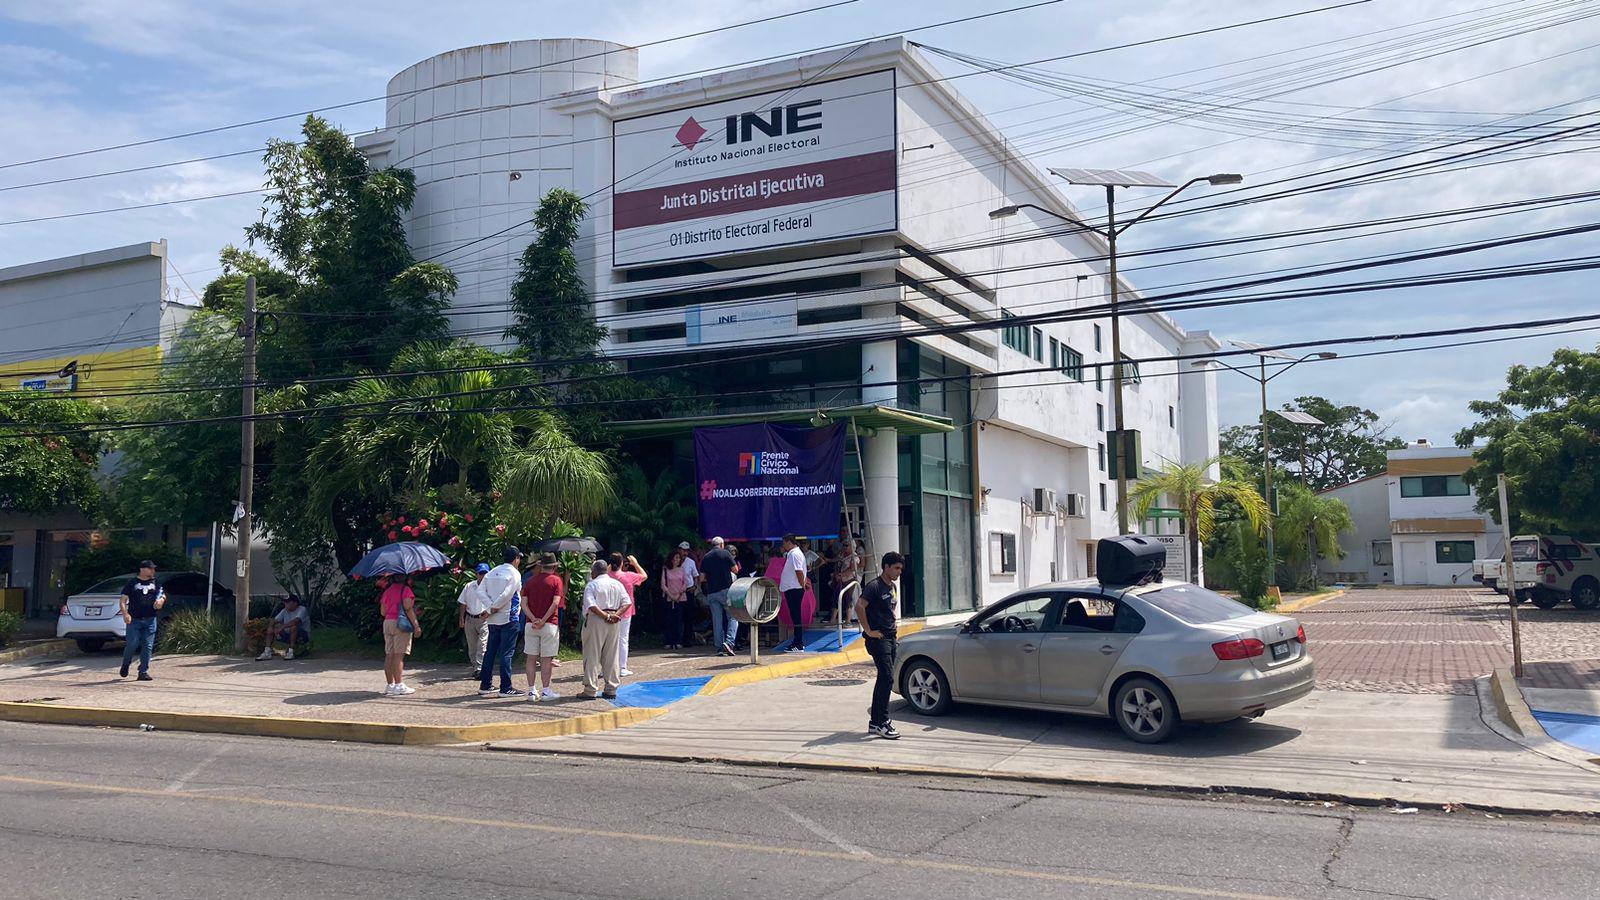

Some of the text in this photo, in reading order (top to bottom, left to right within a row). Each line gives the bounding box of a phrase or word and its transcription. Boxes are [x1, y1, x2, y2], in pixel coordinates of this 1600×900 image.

[727, 99, 822, 145] INE
[675, 136, 820, 168] Instituto Nacional Electoral
[660, 172, 824, 210] Junta Distrital Ejecutiva
[685, 228, 722, 244] Distrito
[725, 220, 771, 239] Electoral
[773, 214, 813, 233] Federal
[718, 315, 737, 324] INE
[761, 452, 789, 460] Frente
[761, 459, 788, 467] Cívico
[761, 467, 799, 475] Nacional
[701, 480, 836, 500] #NOALASOBRERREPRESENTACIÓN
